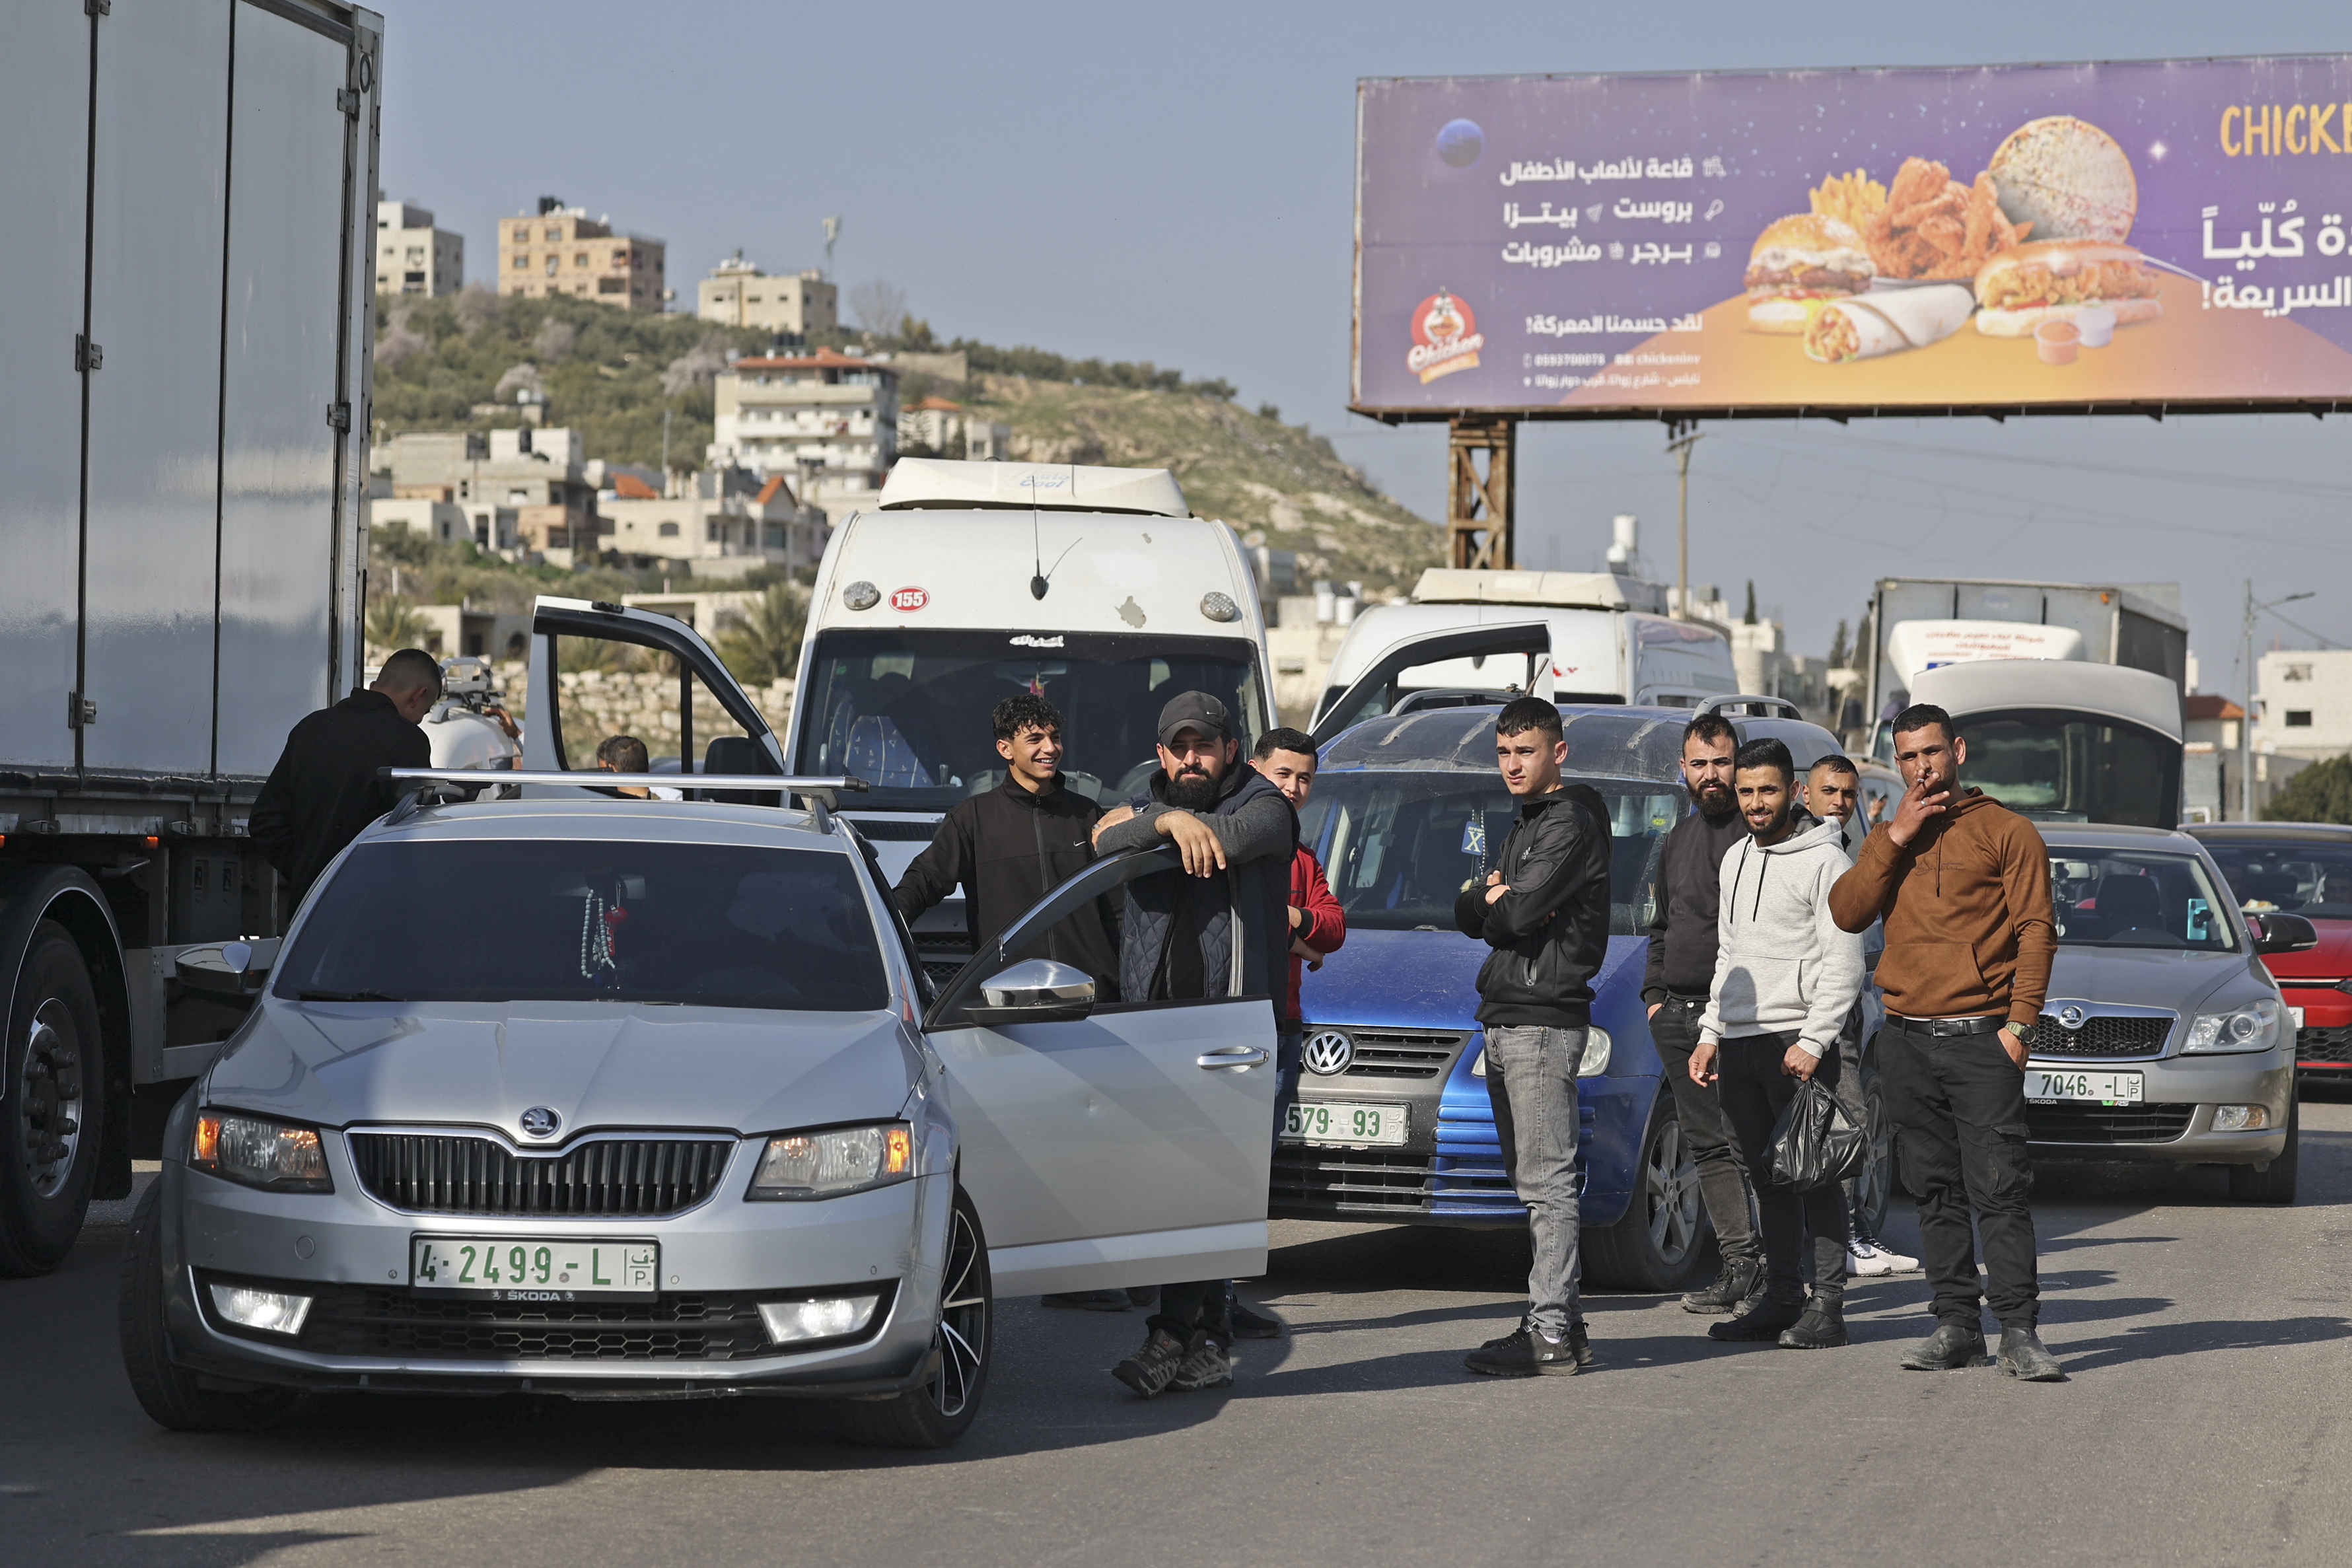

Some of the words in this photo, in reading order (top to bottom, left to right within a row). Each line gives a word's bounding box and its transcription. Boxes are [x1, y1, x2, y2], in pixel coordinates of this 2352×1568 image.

[1499, 157, 1575, 186] الأطفال
[1578, 155, 1642, 185] لألعاب
[1645, 157, 1693, 179] قاعة
[1613, 197, 1693, 223] بروست
[1501, 234, 1602, 268] مشروبات
[1630, 242, 1693, 266] برجر
[2201, 275, 2351, 317] السريعة!
[1526, 314, 1604, 338] المعركة!
[1605, 314, 1668, 333] حسمنا
[1671, 313, 1703, 332] لقد
[895, 591, 925, 608] 155
[1464, 830, 1483, 853] X
[2130, 1087, 2139, 1098] P
[635, 1270, 646, 1286] P
[507, 1290, 561, 1301] ŠKODA
